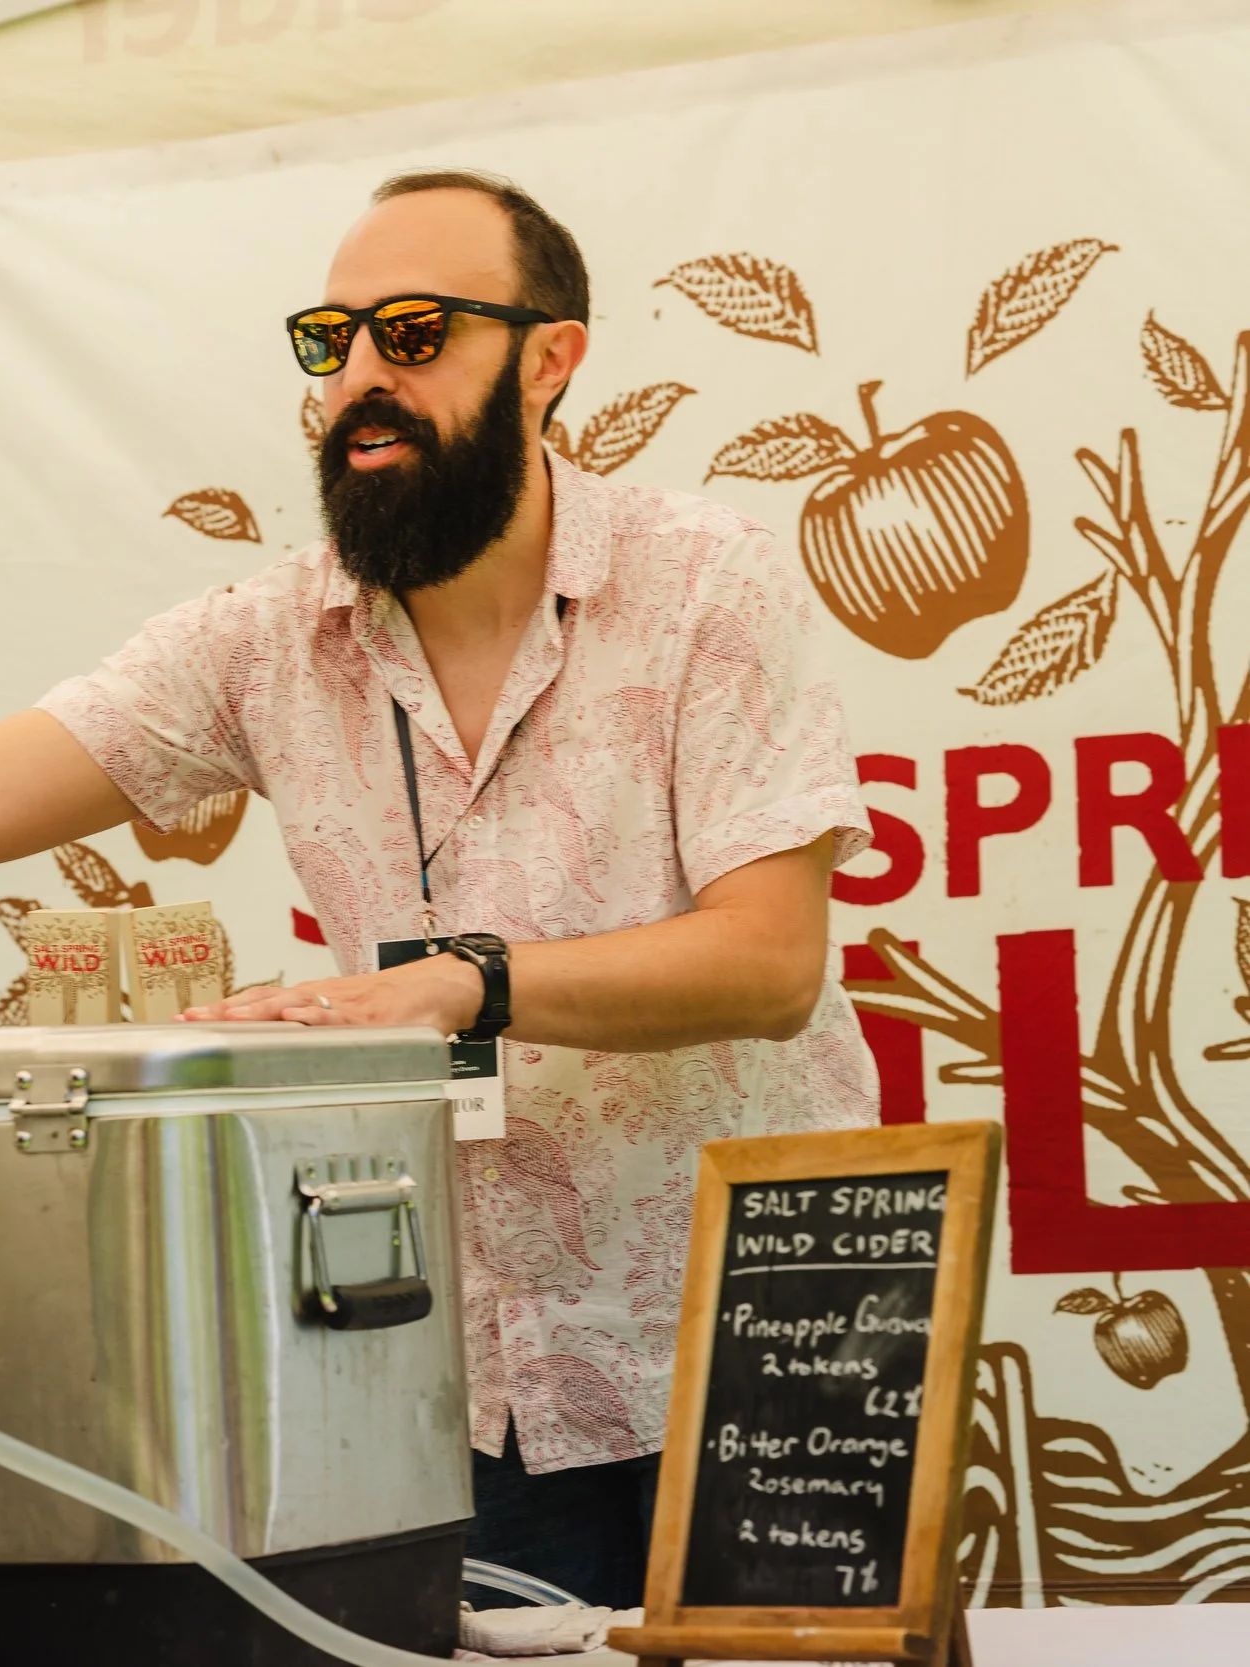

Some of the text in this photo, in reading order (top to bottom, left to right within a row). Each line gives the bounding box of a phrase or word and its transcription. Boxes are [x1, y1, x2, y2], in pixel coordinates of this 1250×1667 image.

[35, 954, 101, 972] WILD
[142, 943, 210, 968] WILD
[744, 1184, 949, 1219] SALT SPRING
[736, 1228, 935, 1258] WILD CIDER
[762, 1352, 879, 1380] 2 tokens
[807, 1426, 909, 1468] Orange
[739, 1518, 867, 1554] 2 tokens
